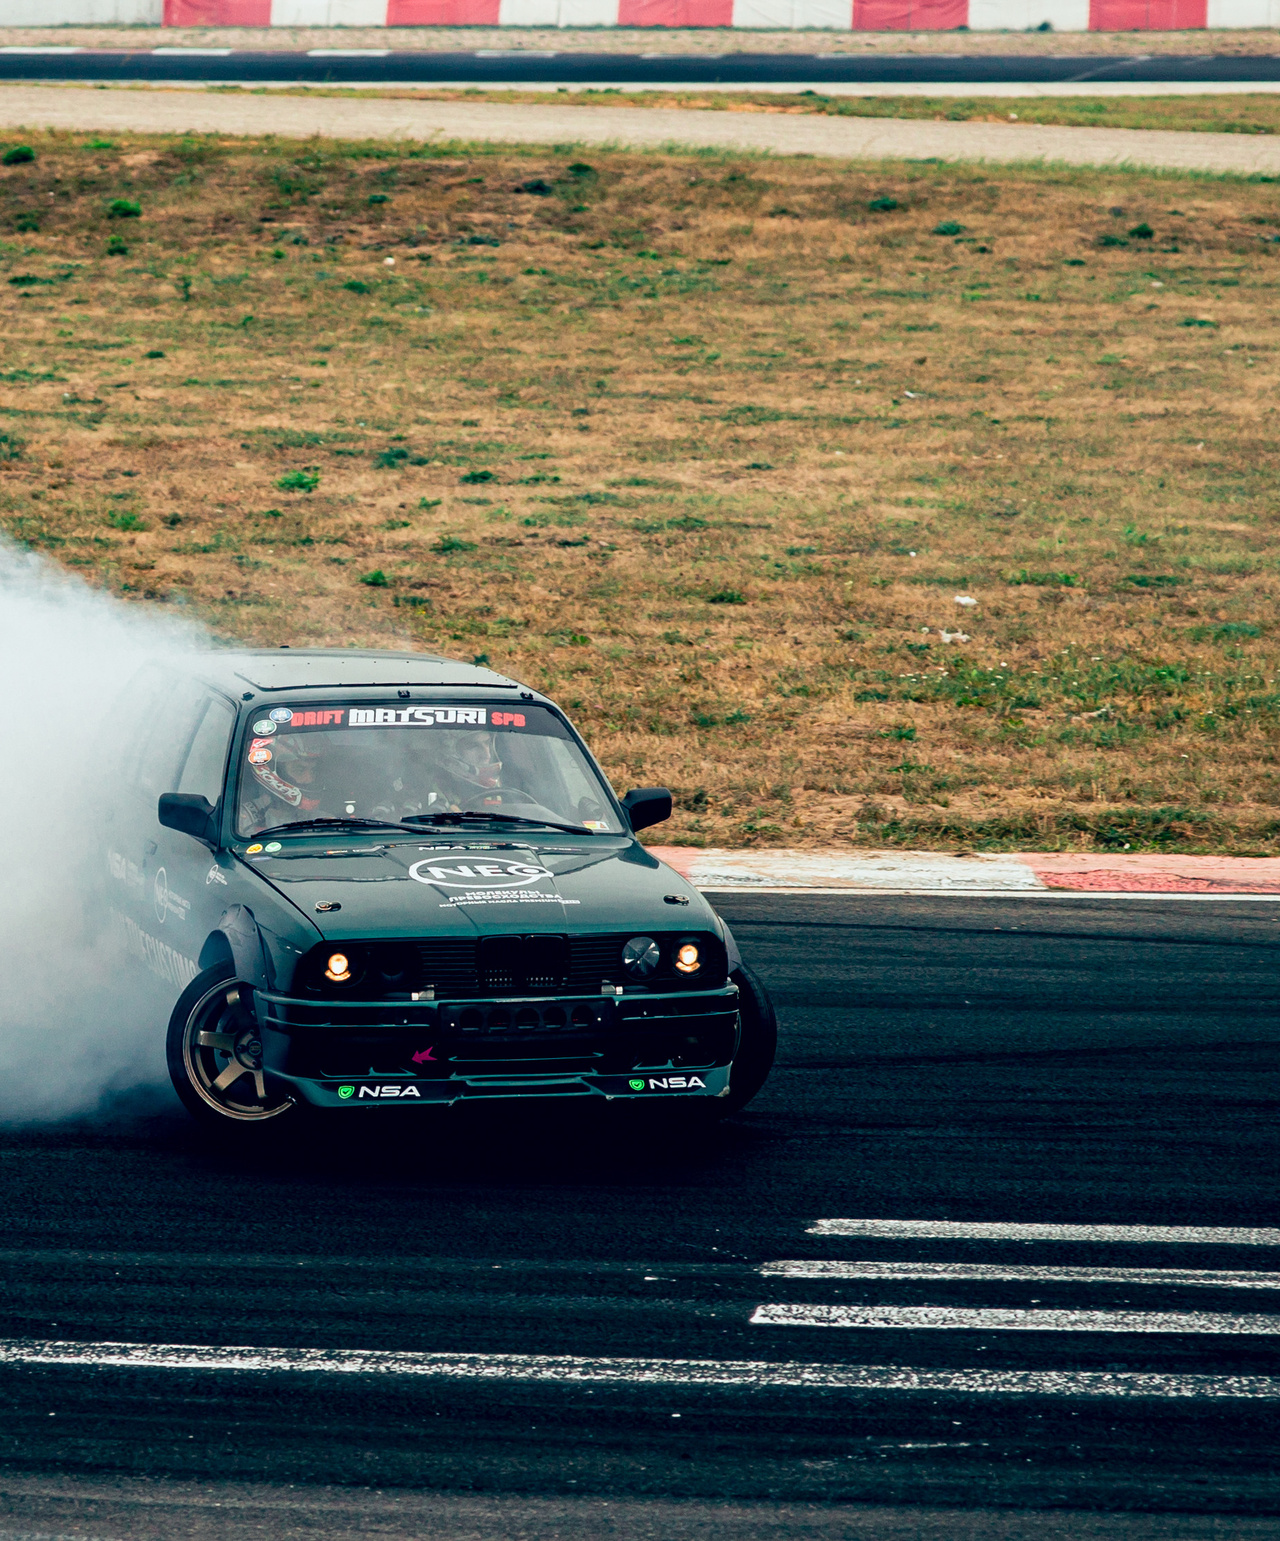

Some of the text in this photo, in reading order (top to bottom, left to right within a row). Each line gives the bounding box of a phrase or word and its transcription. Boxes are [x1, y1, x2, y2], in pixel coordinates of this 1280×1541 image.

[290, 710, 345, 727] DRIFT
[348, 706, 487, 726] MATSURI
[491, 711, 526, 727] SPB
[648, 1076, 706, 1090] NSA
[359, 1085, 421, 1098] NSA
